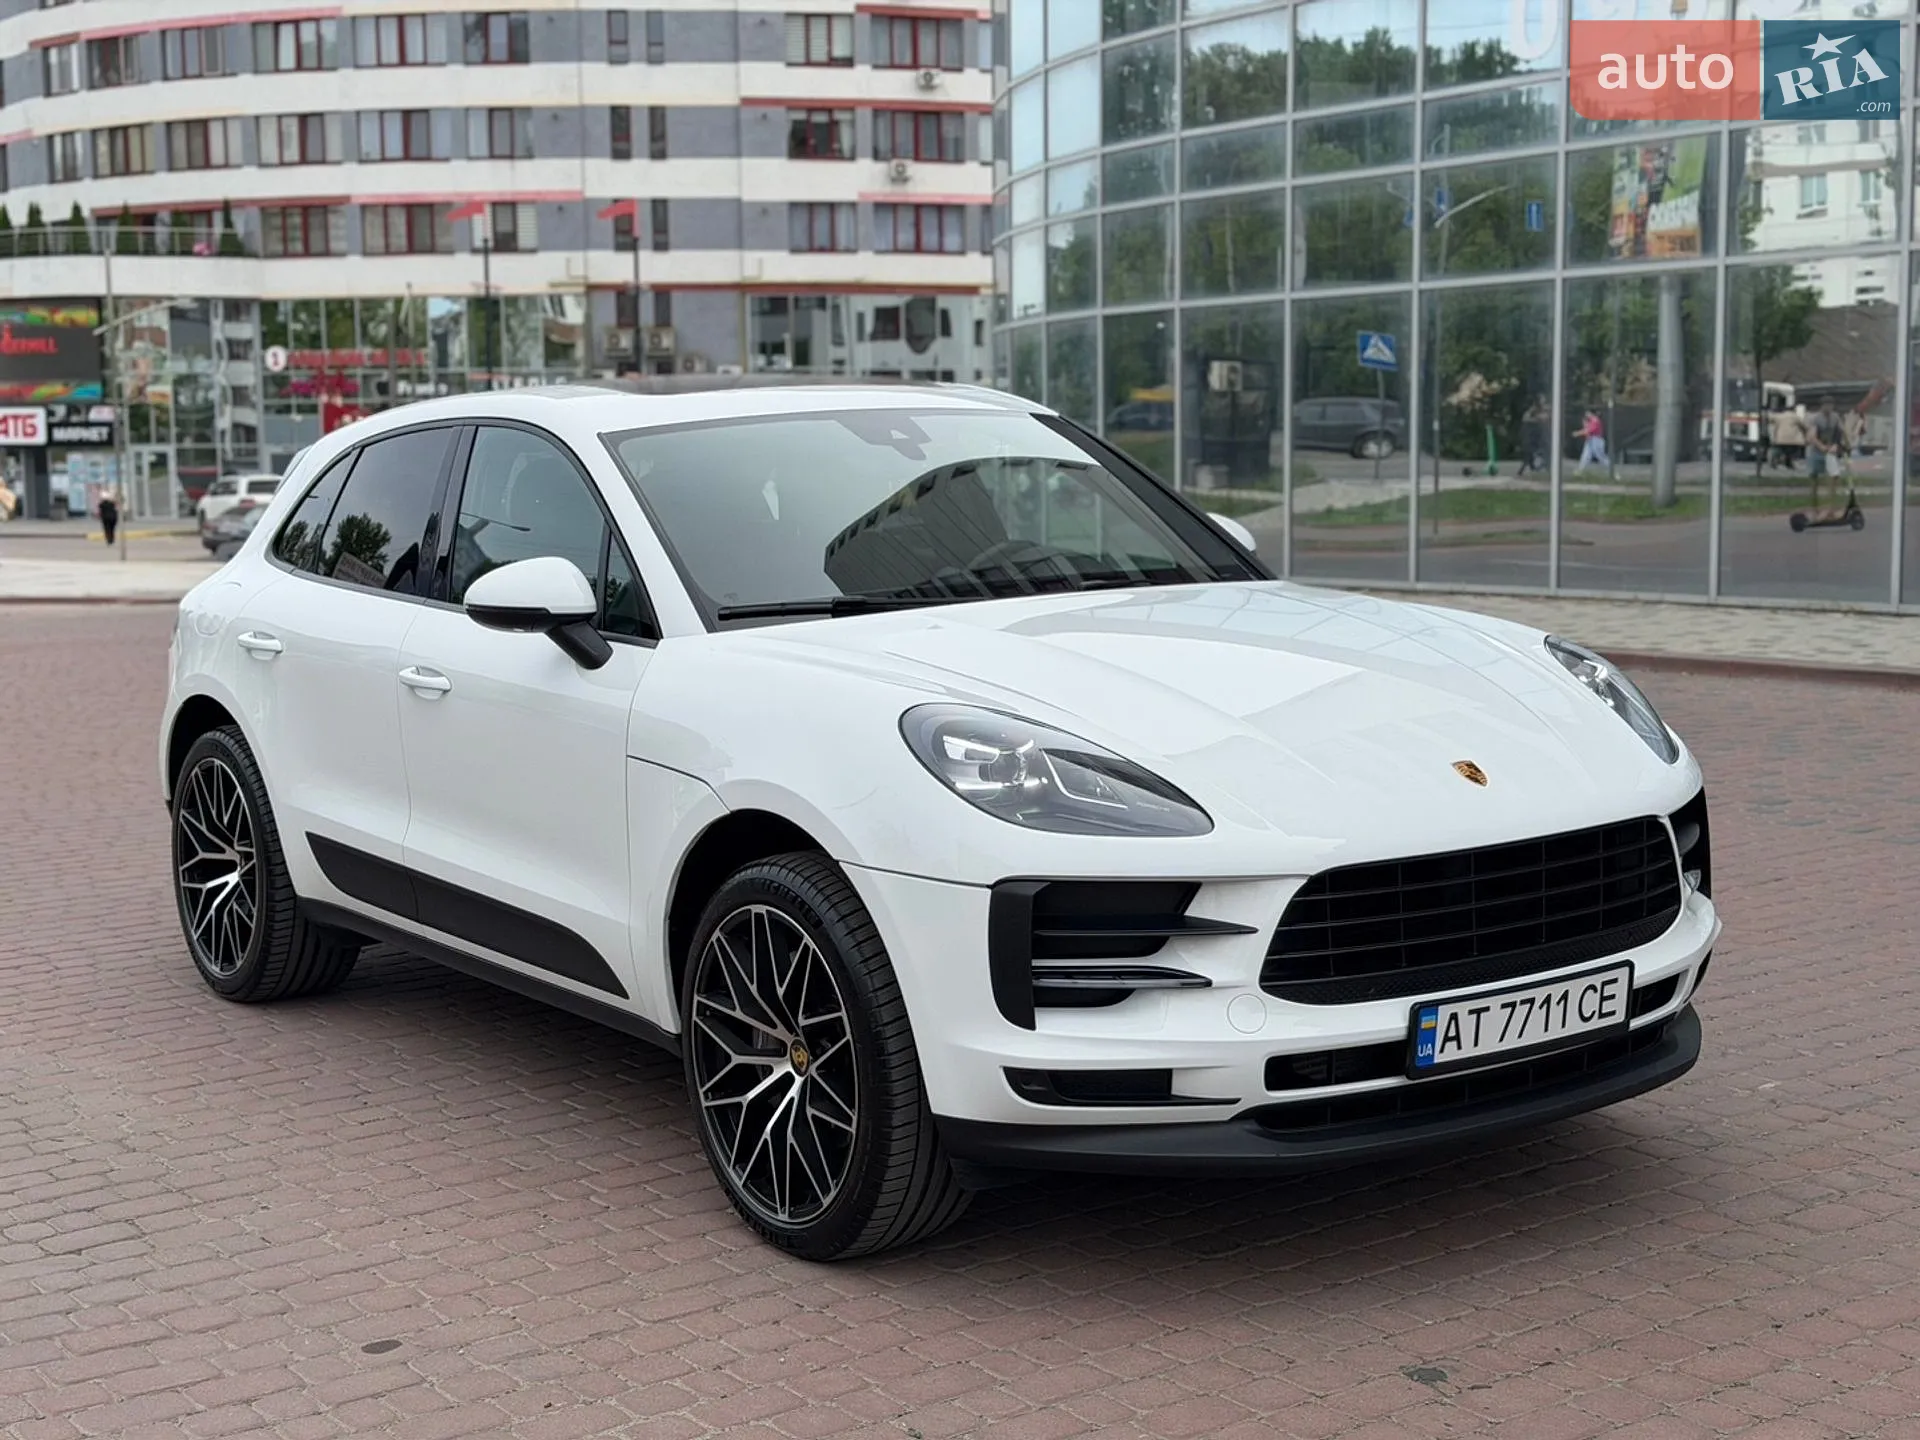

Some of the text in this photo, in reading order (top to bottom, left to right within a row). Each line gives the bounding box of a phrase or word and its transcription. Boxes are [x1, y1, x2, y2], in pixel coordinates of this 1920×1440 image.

[1439, 978, 1618, 1054] AT 7711 CE
[1418, 1043, 1433, 1057] UA
